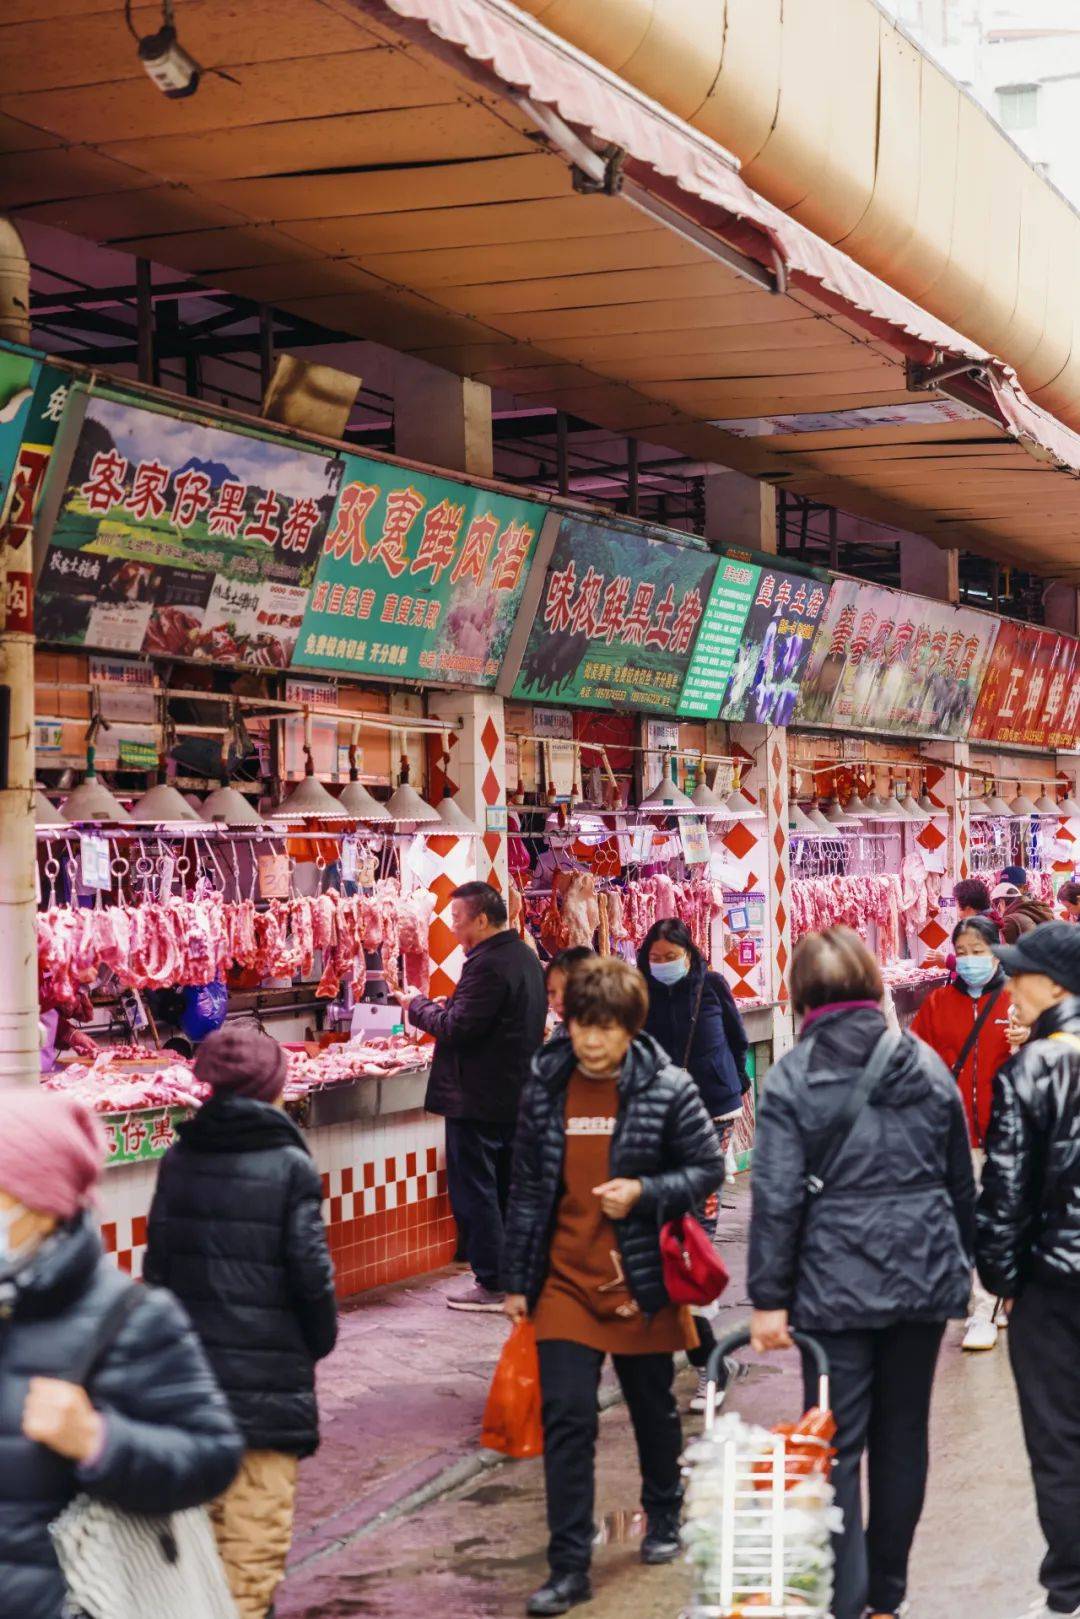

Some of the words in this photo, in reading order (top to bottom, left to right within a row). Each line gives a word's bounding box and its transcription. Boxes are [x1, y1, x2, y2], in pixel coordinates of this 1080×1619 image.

[82, 448, 323, 553] 客家仔黑土猪
[323, 480, 536, 593] 双惠鲜肉档
[311, 581, 377, 620] 诚信经营
[380, 593, 442, 630] 童叟无欺
[544, 560, 703, 655] 味极鲜黑土猪
